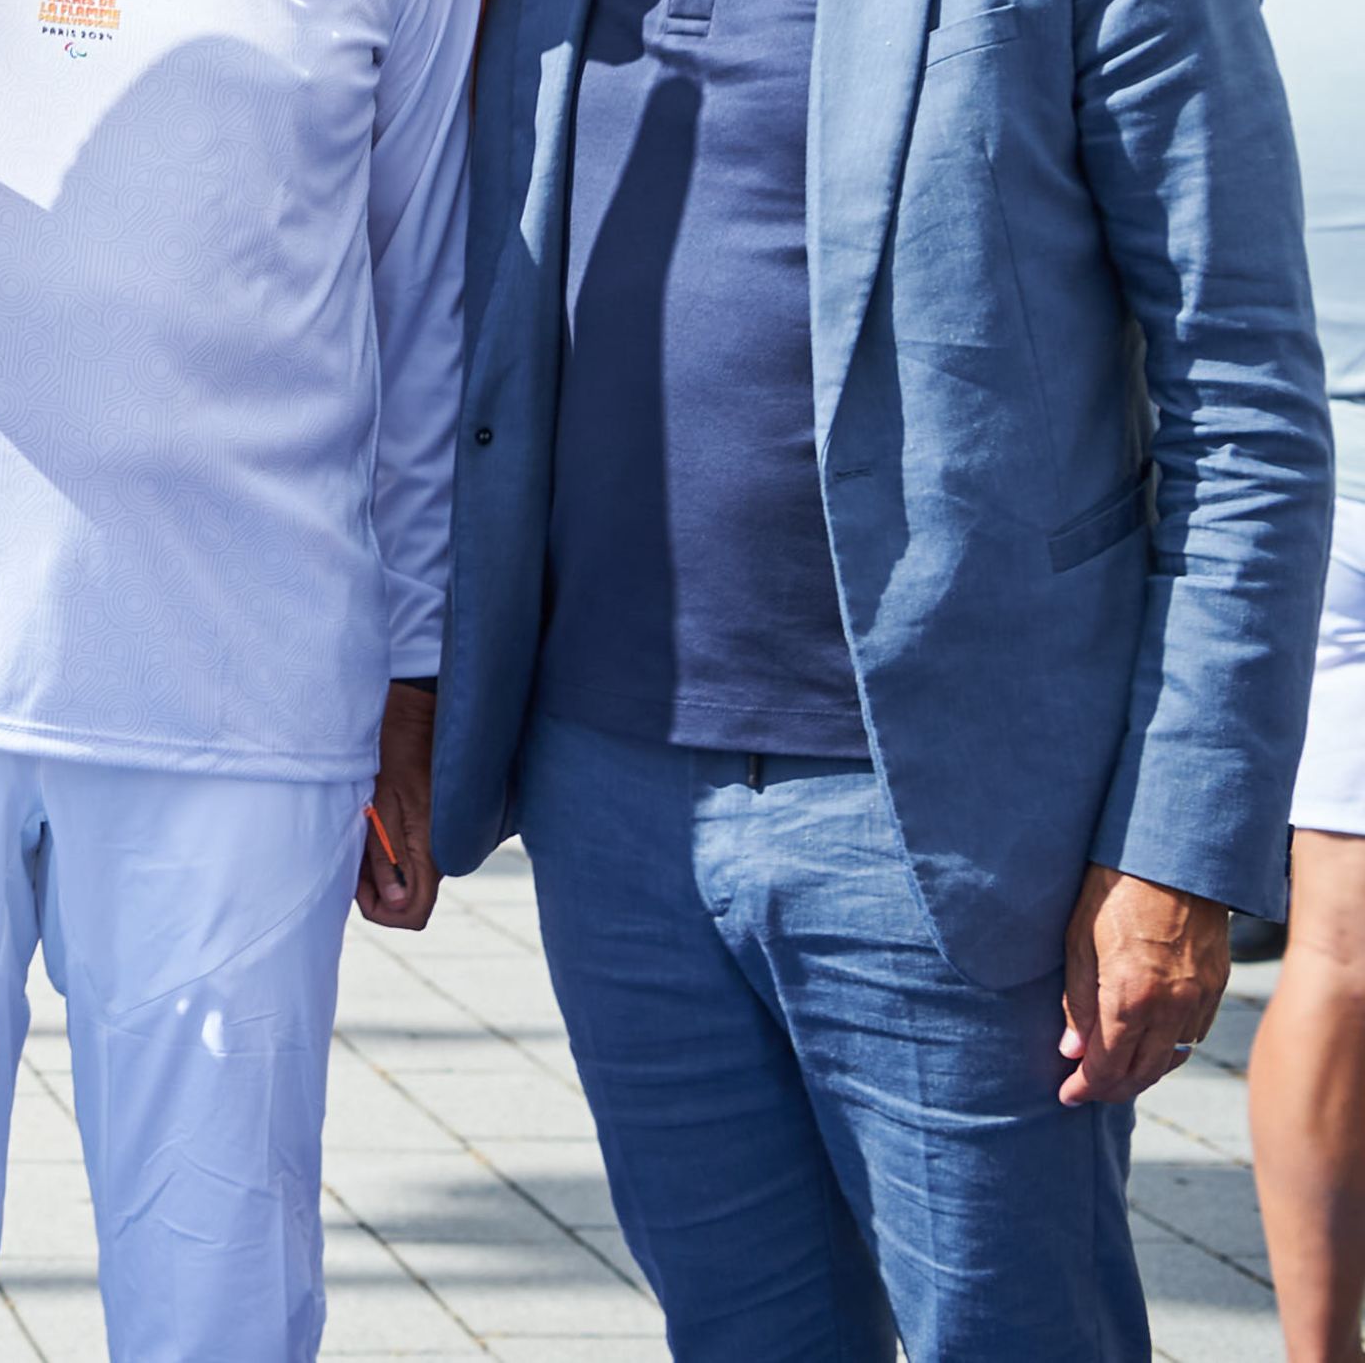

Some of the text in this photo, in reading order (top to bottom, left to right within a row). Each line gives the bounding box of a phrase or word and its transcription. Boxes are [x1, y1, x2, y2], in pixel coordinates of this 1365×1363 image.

[40, 0, 121, 19] LA FLAMME
[41, 25, 113, 41] PARIS 2024
